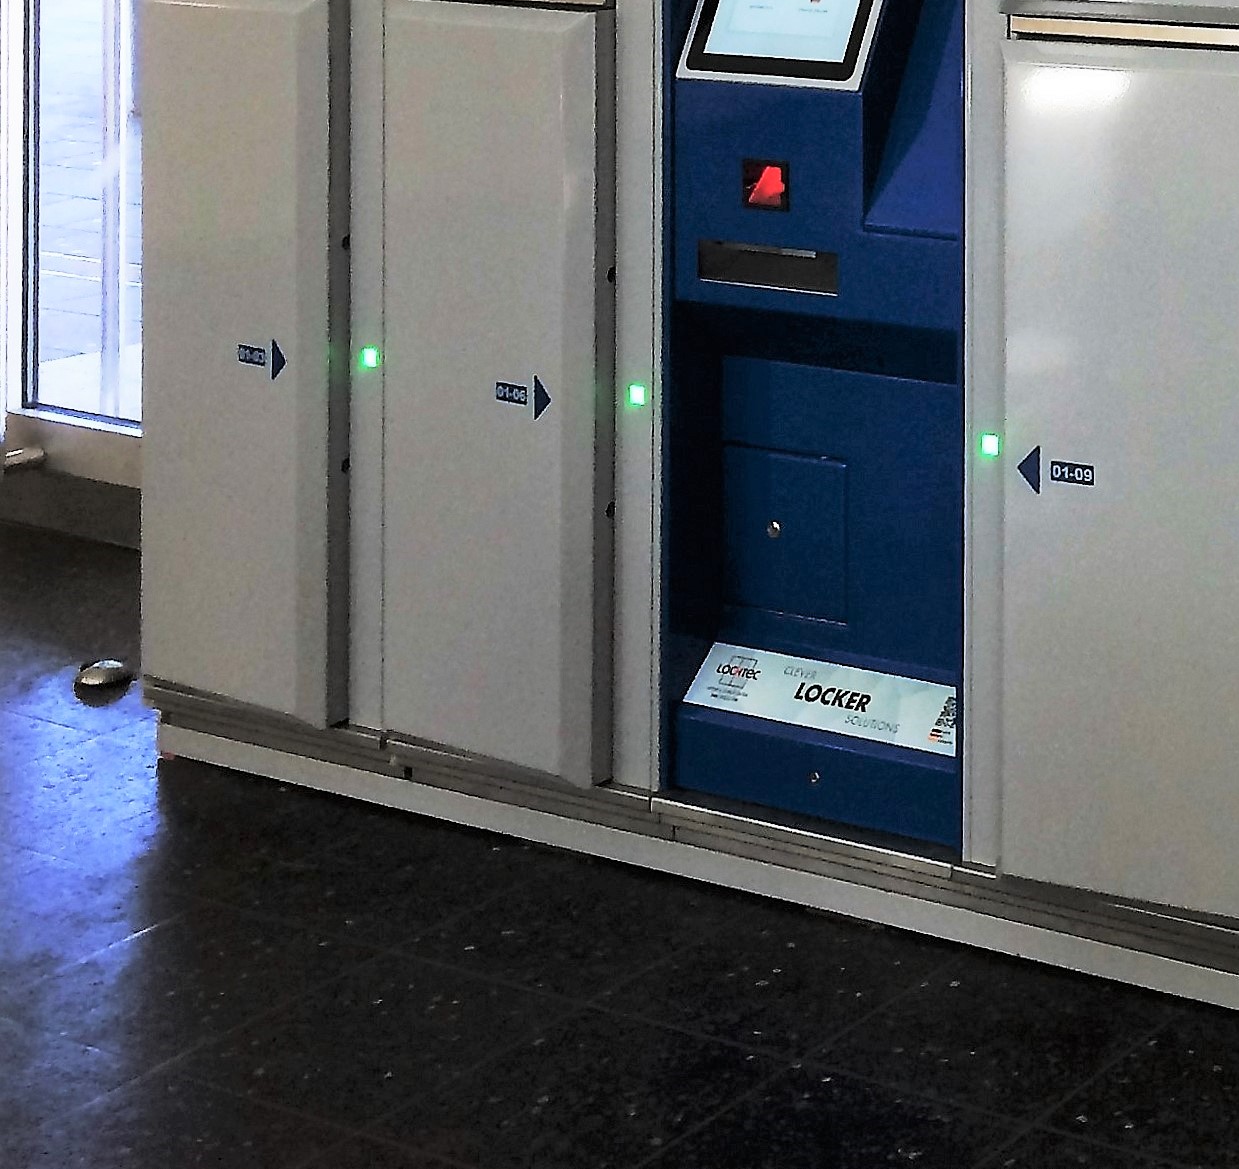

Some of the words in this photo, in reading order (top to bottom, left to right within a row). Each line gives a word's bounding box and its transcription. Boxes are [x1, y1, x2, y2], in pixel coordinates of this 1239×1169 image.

[1052, 464, 1092, 482] 01-09
[794, 682, 872, 713] LOCKER
[845, 715, 900, 734] SOLUTIONS
